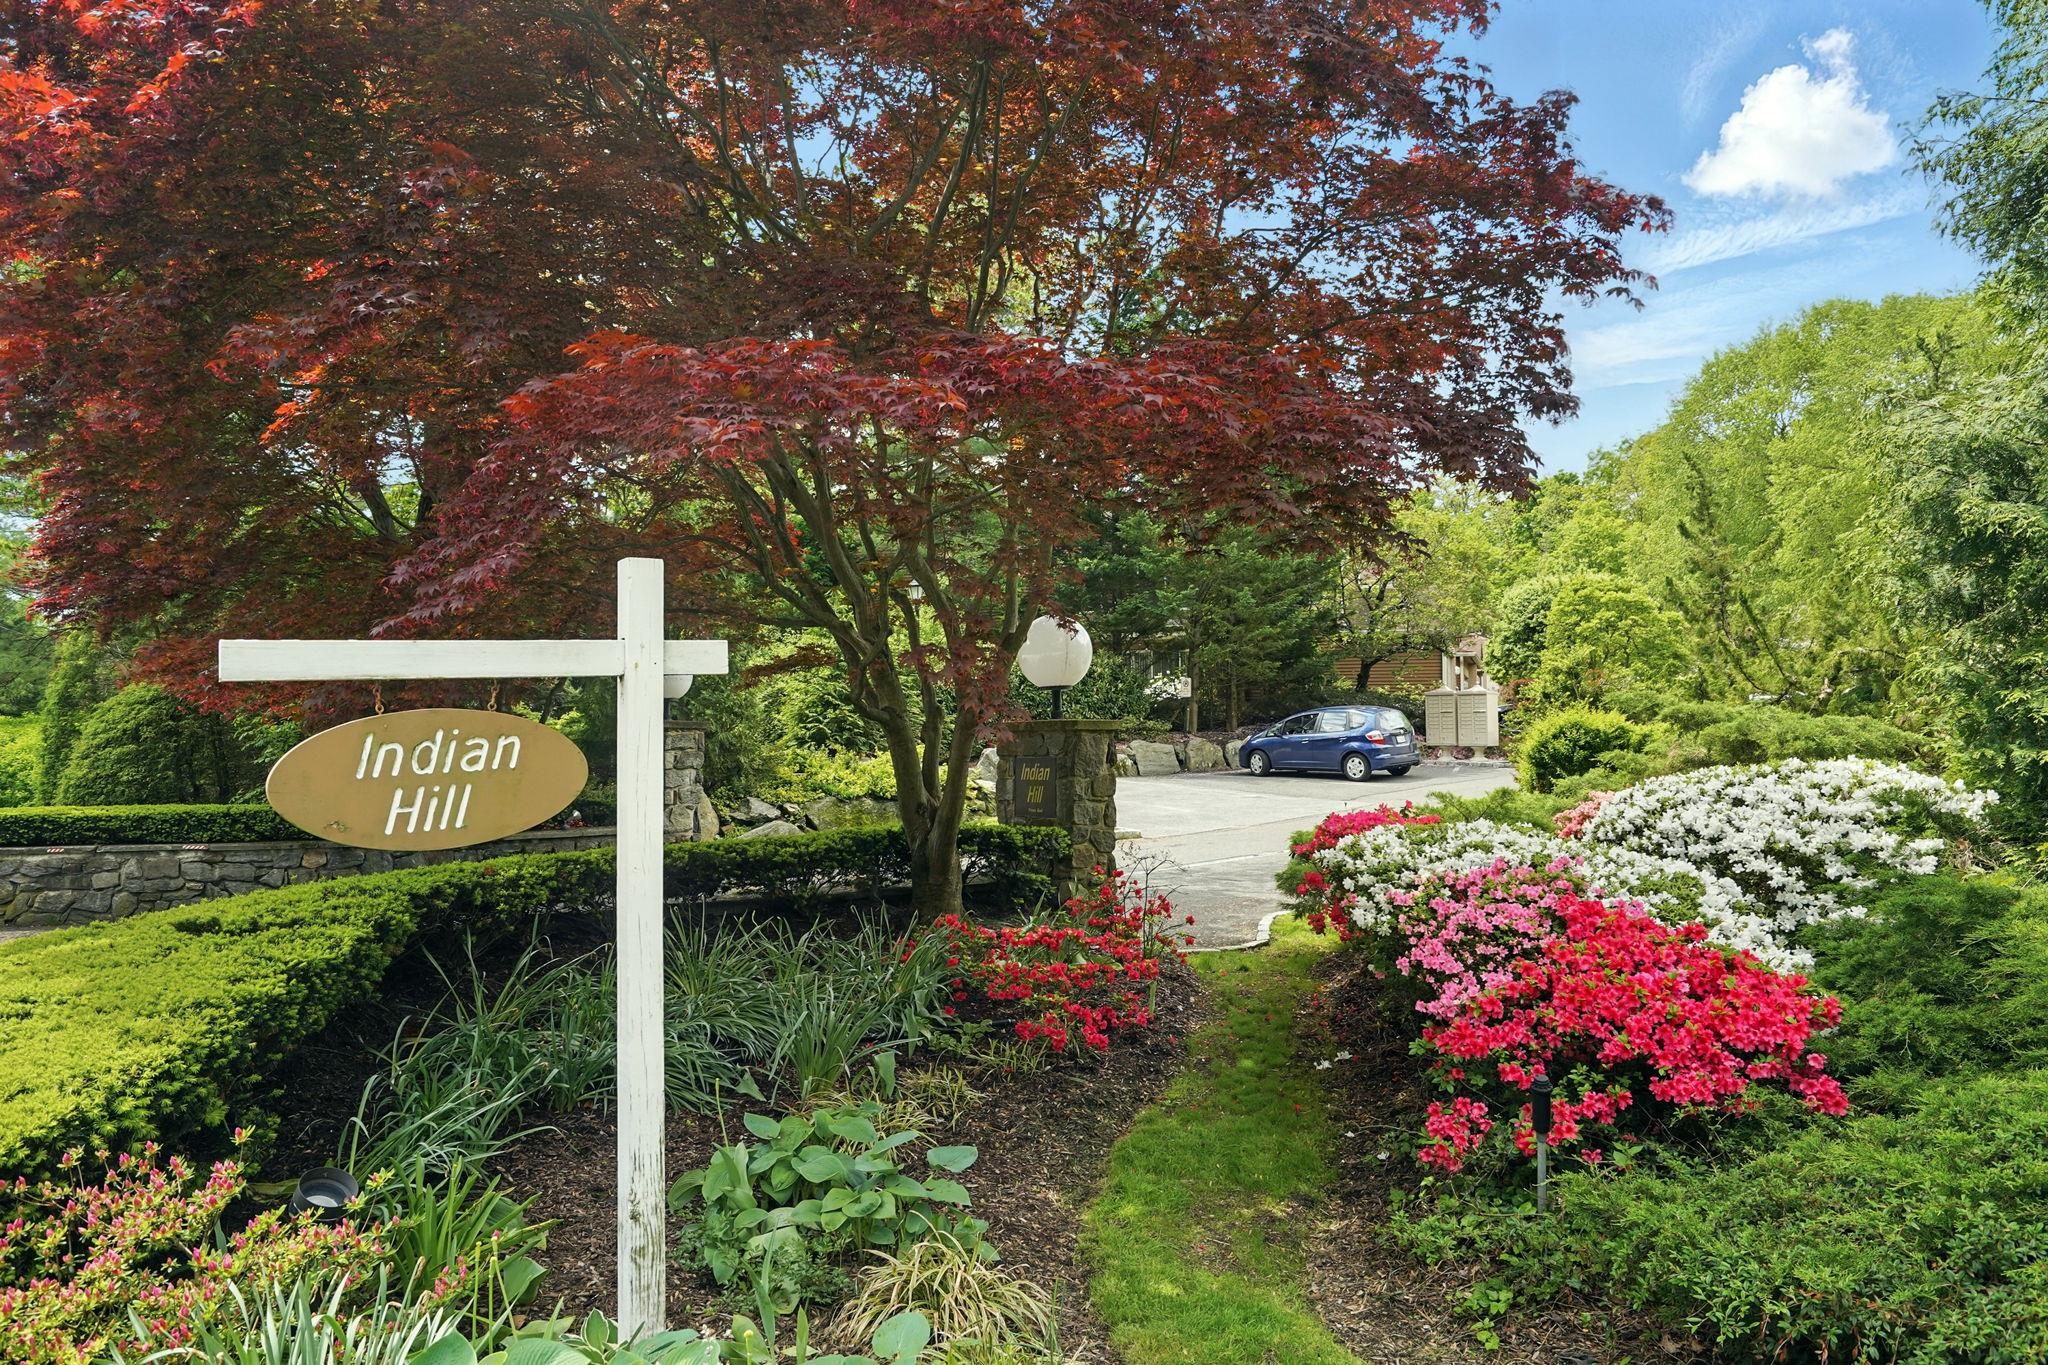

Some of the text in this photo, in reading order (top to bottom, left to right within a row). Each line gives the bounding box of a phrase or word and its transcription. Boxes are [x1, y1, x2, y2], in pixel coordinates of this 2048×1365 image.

[356, 728, 521, 779] Indian
[1020, 763, 1051, 781] Indian
[384, 783, 472, 835] Hill
[1027, 785, 1044, 803] Hill
